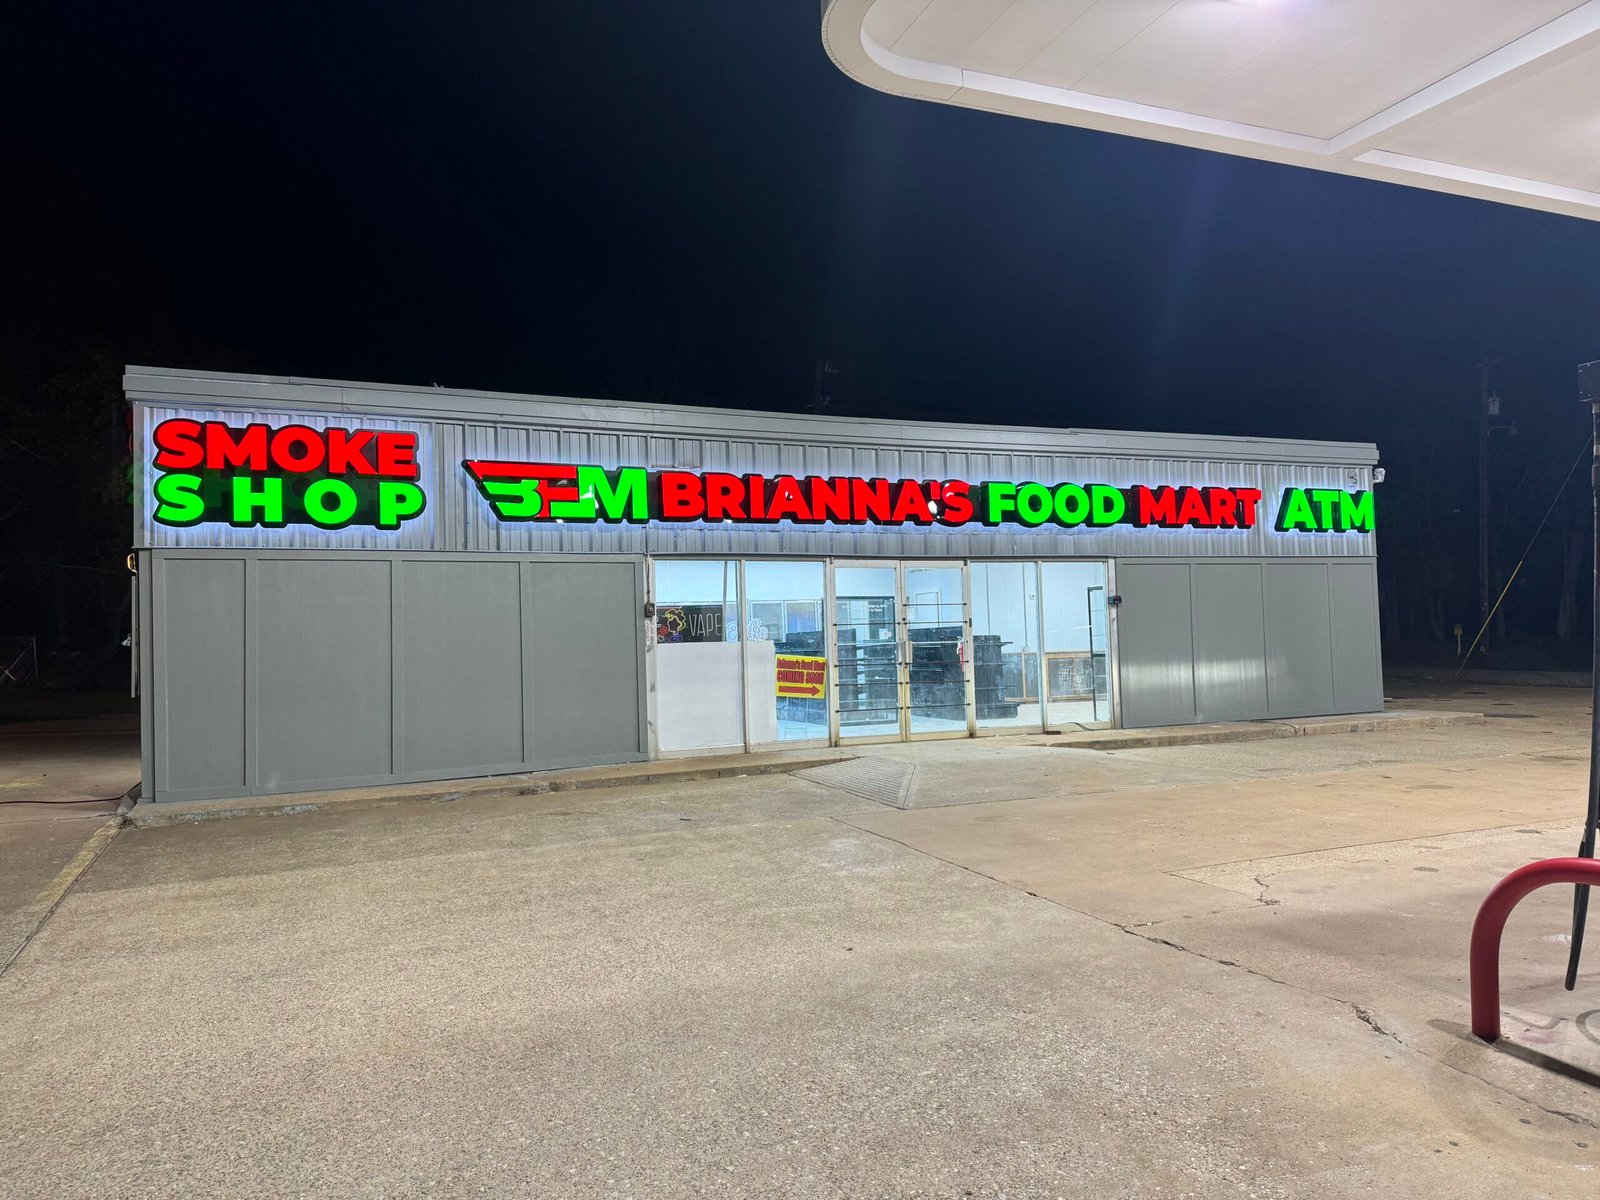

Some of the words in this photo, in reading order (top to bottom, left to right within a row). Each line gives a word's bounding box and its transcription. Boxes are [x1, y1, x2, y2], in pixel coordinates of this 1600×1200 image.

[156, 420, 417, 477] SMOKE
[157, 473, 423, 525] SHOP
[661, 472, 974, 523] BRIANNA'S
[988, 482, 1126, 524] FOOD
[1139, 486, 1262, 526] MART
[1282, 488, 1376, 532] ATM
[689, 613, 722, 637] VAPE
[776, 669, 805, 684] COMING
[805, 671, 825, 685] SOON
